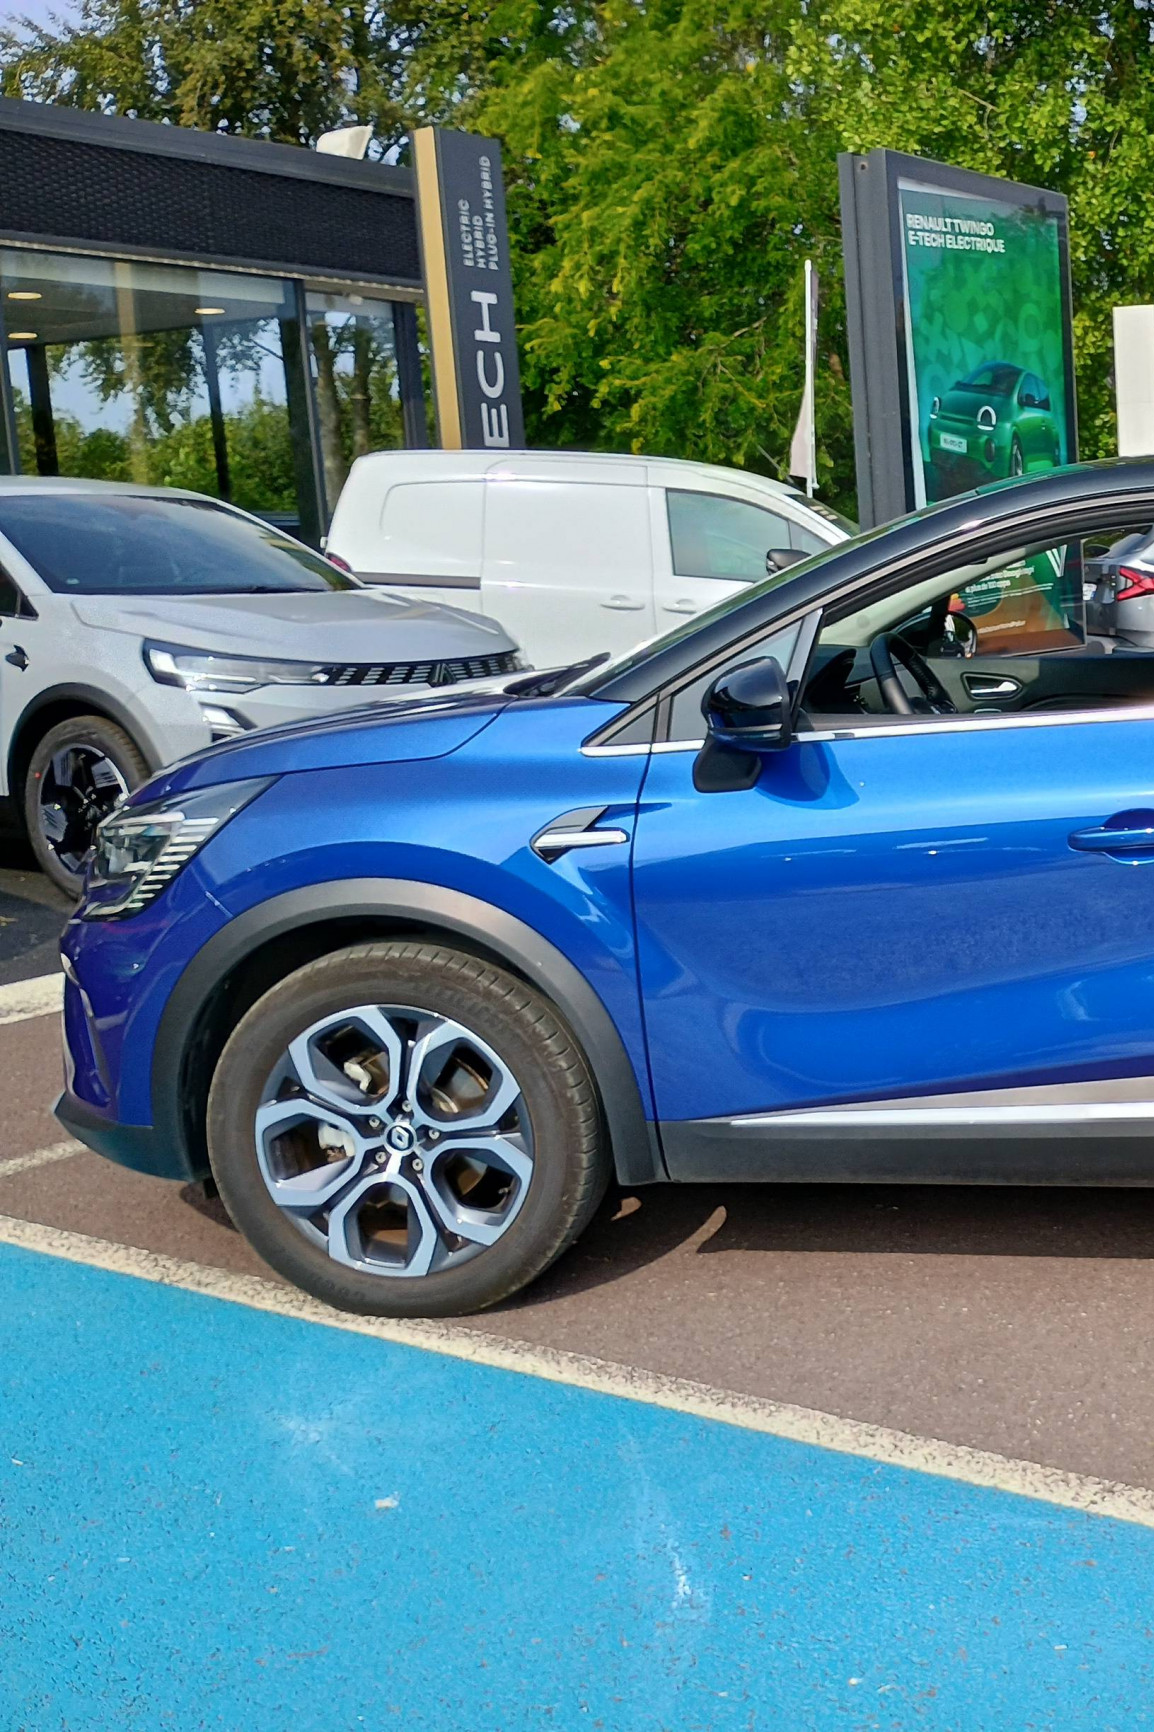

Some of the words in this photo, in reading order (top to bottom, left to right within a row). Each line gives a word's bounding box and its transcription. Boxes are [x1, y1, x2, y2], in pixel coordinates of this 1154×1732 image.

[478, 155, 494, 209] HYBRID
[458, 199, 475, 267] ELECTRIC
[472, 215, 487, 269] HYBRID
[484, 212, 499, 271] PLUG-IN
[906, 213, 951, 232] RENAULT
[951, 219, 995, 236] TWINGO
[908, 230, 945, 248] E-TECH
[945, 234, 1006, 254] ELECTRIQUE
